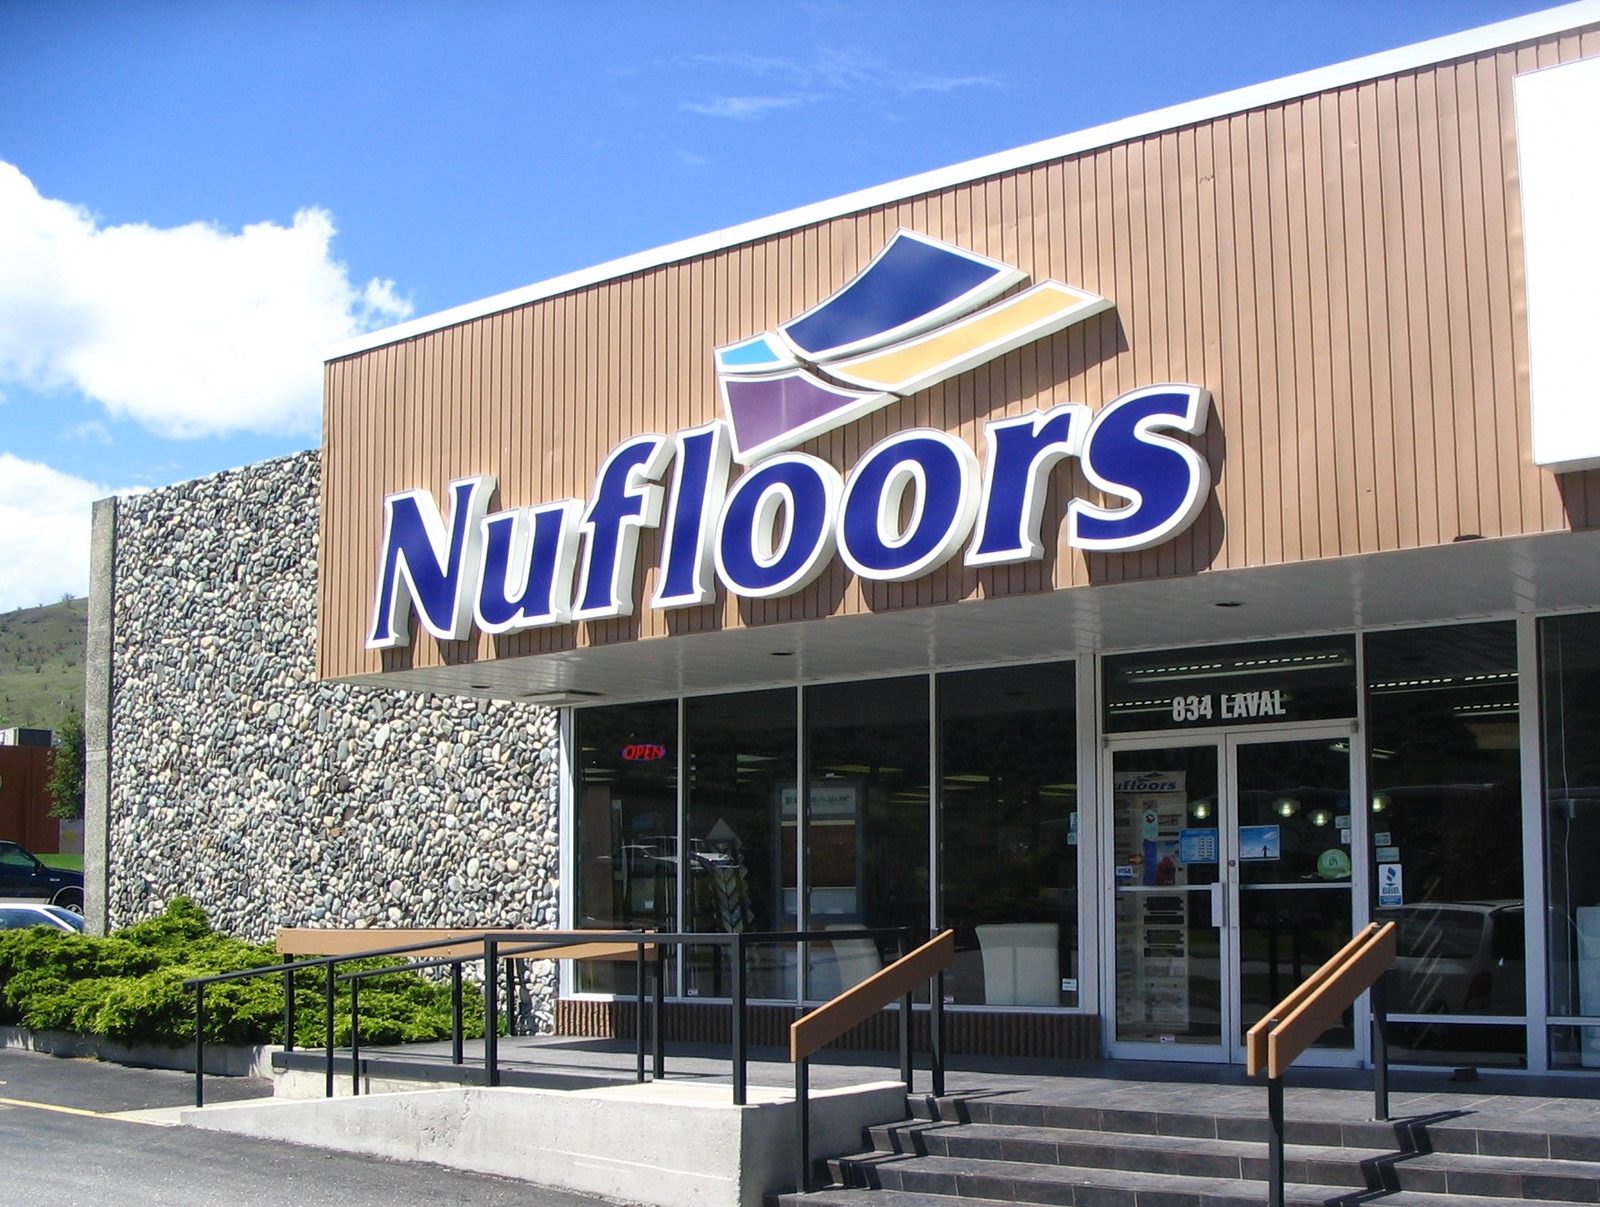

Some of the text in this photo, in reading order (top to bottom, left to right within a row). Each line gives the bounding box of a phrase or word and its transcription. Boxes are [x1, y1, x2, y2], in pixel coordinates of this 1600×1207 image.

[365, 382, 1211, 650] Nufloors
[1172, 689, 1287, 723] 834 LAVAL
[622, 744, 666, 760] OPEN
[1115, 780, 1177, 791] ufloors
[1382, 886, 1400, 895] BBB
